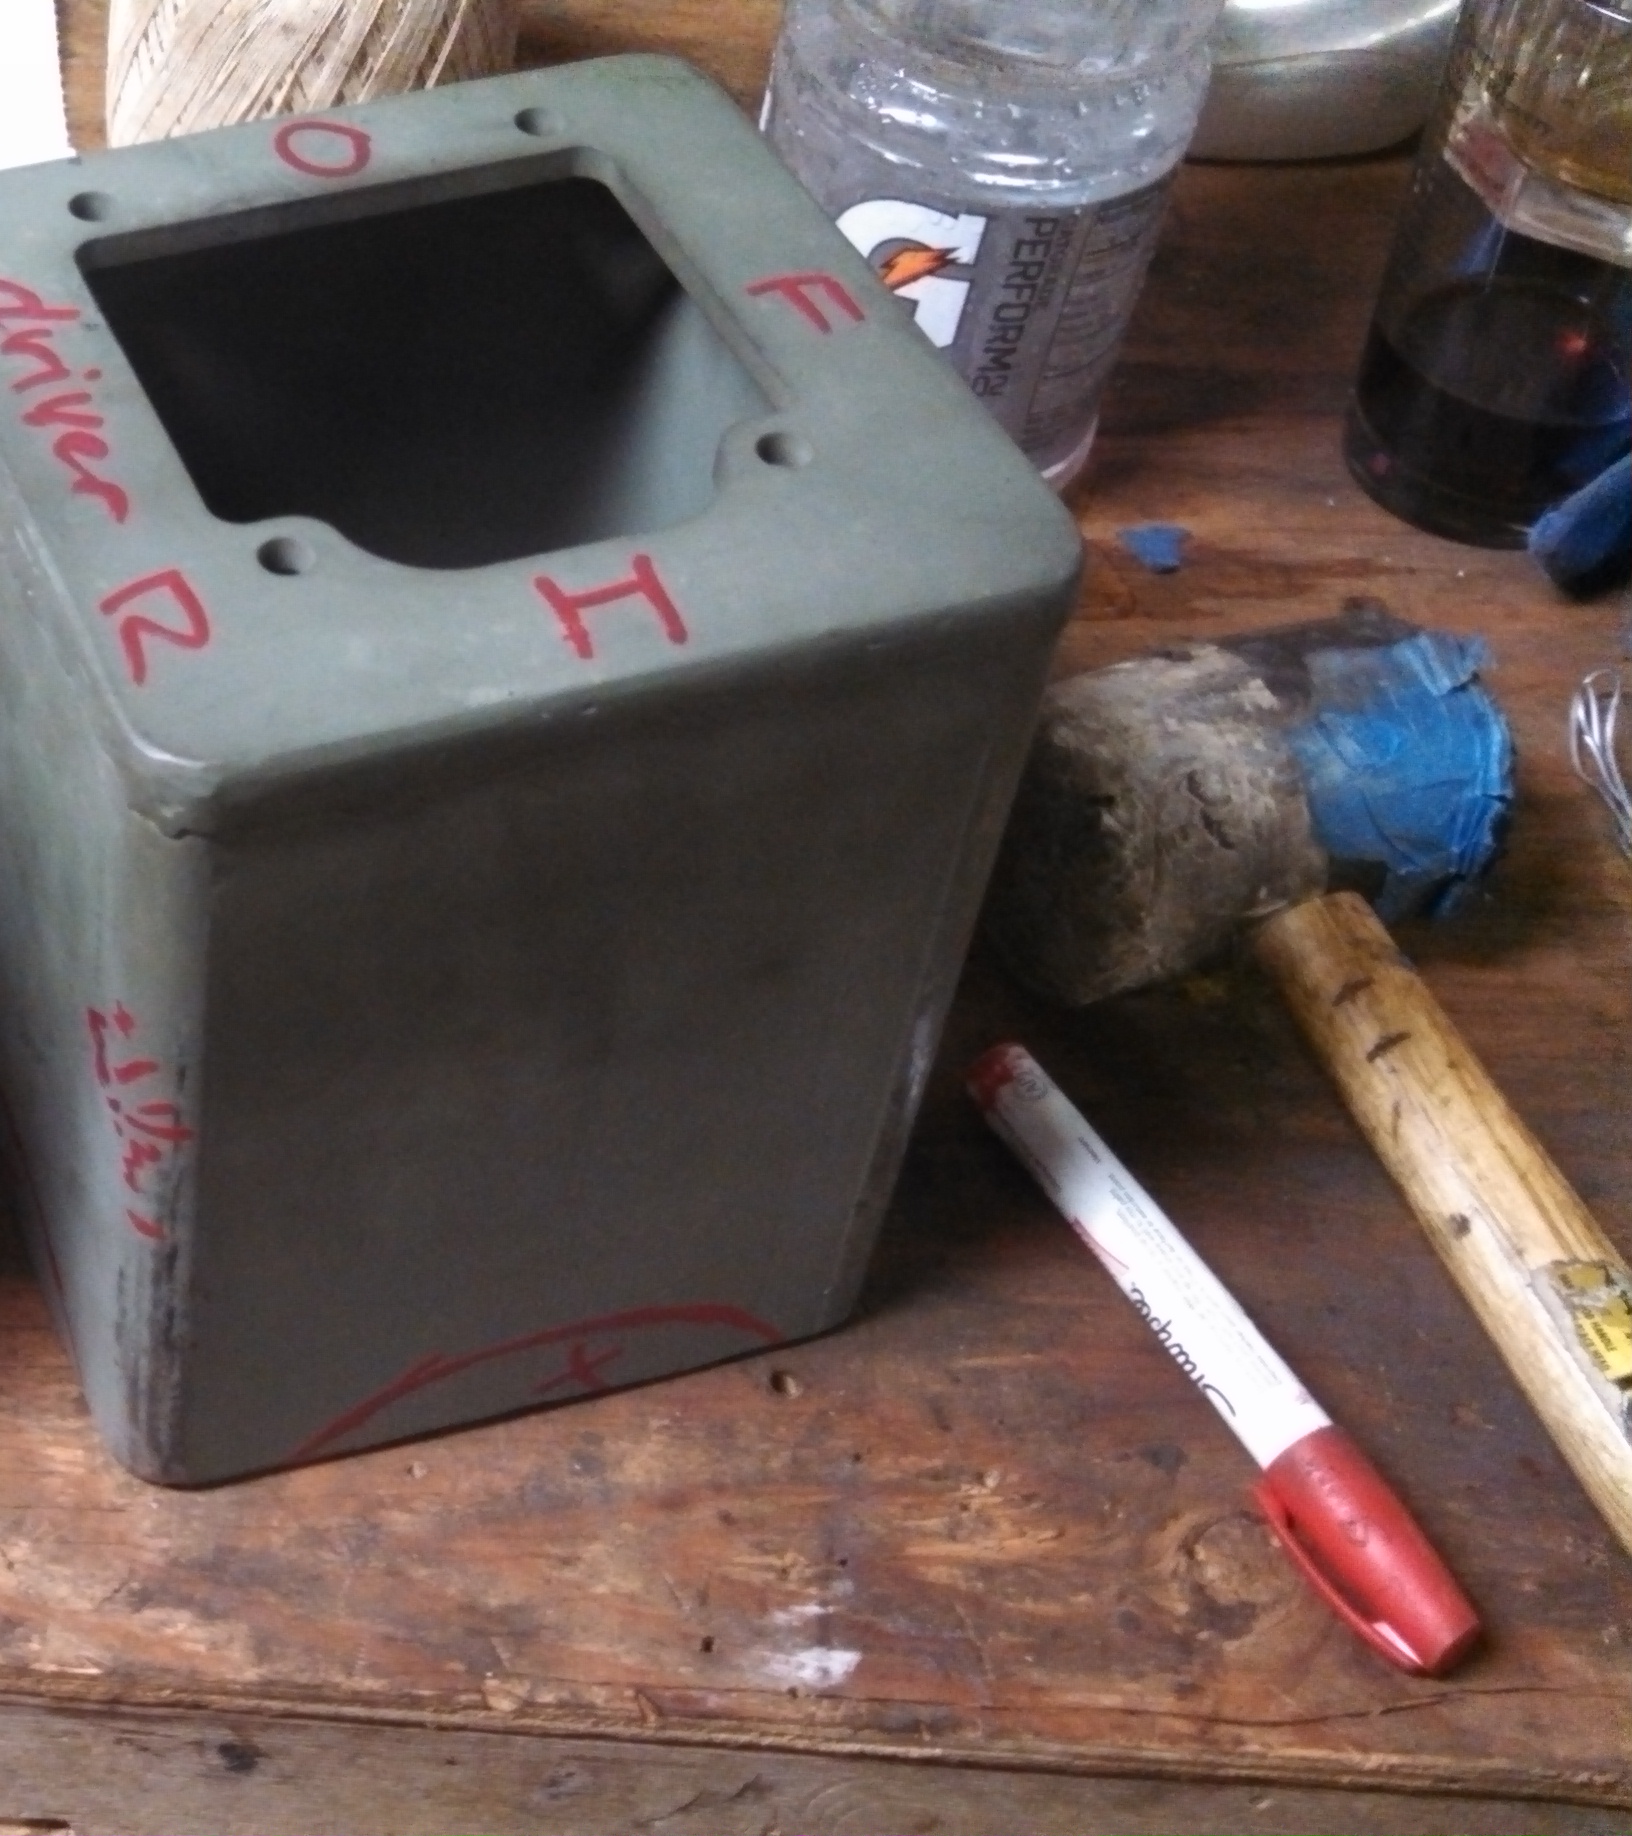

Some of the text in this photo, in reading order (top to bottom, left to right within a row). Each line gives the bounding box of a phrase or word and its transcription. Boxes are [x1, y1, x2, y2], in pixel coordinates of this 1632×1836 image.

[275, 119, 370, 176] O
[748, 272, 864, 333] F
[979, 216, 1060, 373] PERFORM
